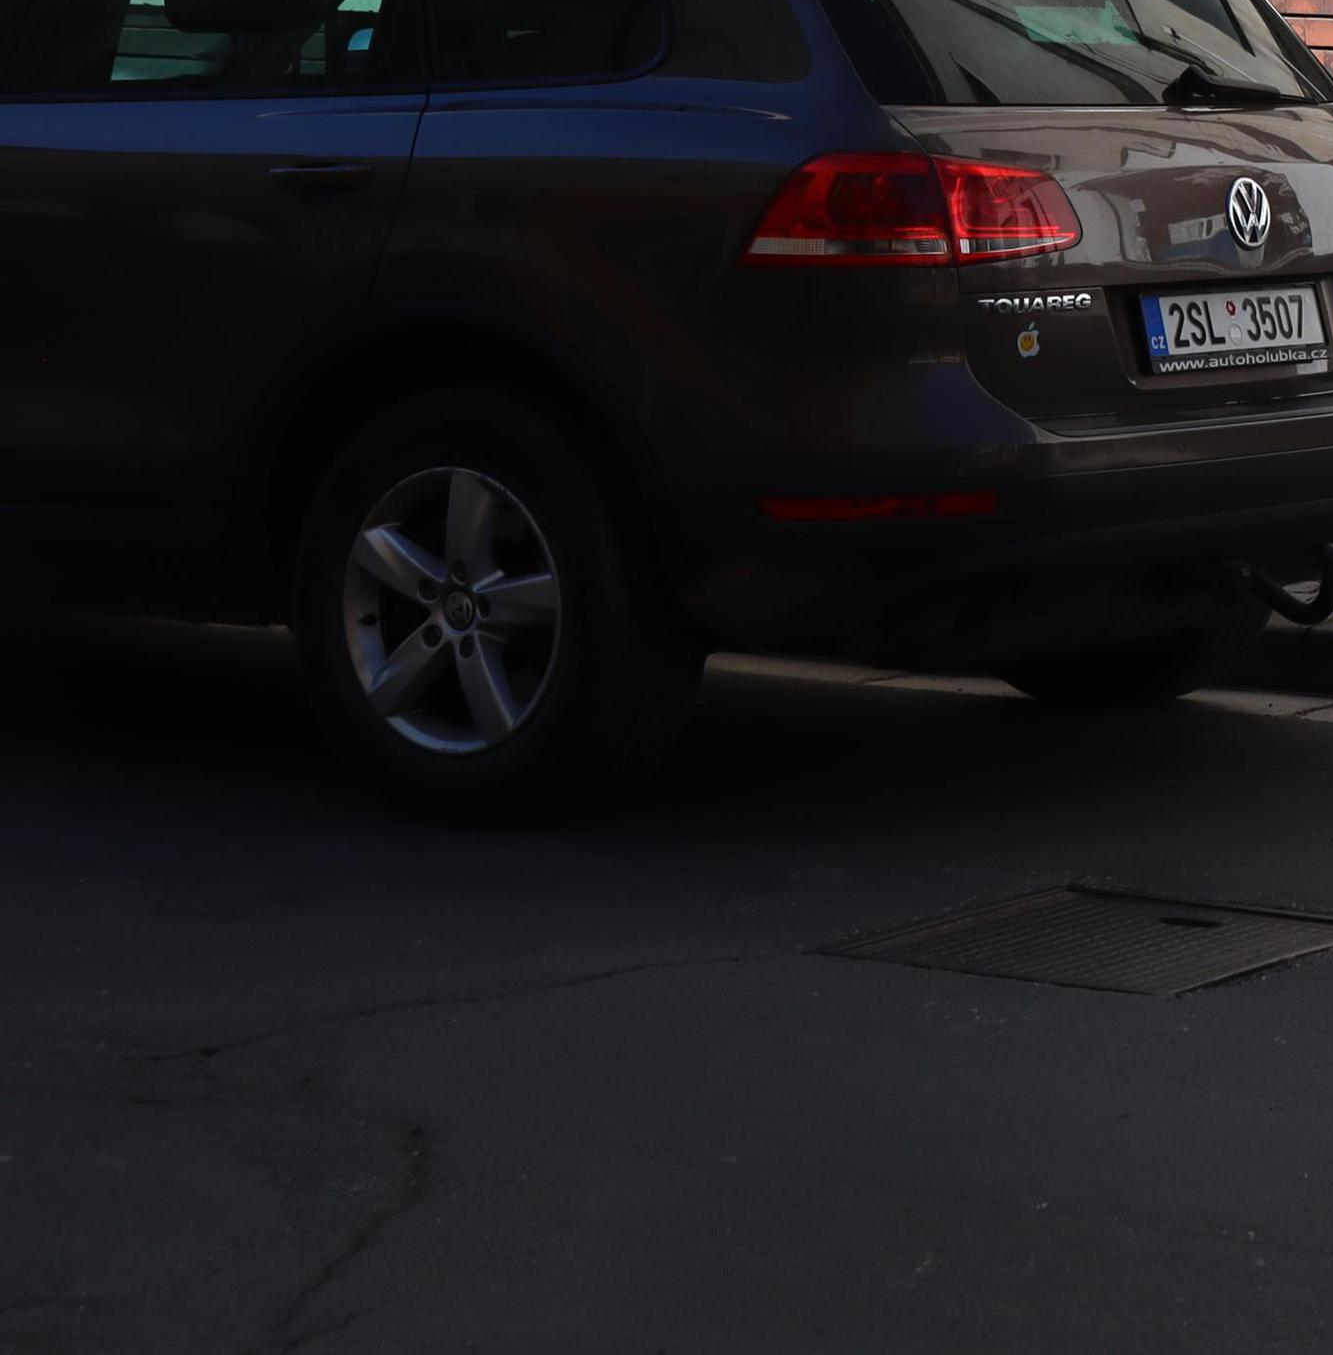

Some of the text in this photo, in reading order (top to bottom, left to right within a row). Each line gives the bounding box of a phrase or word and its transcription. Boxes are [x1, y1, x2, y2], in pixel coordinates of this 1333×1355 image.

[978, 293, 1092, 313] TOUAREG
[1151, 294, 1304, 350] CZ 2SL 3507
[1159, 348, 1328, 373] www.autoholubka.cz
